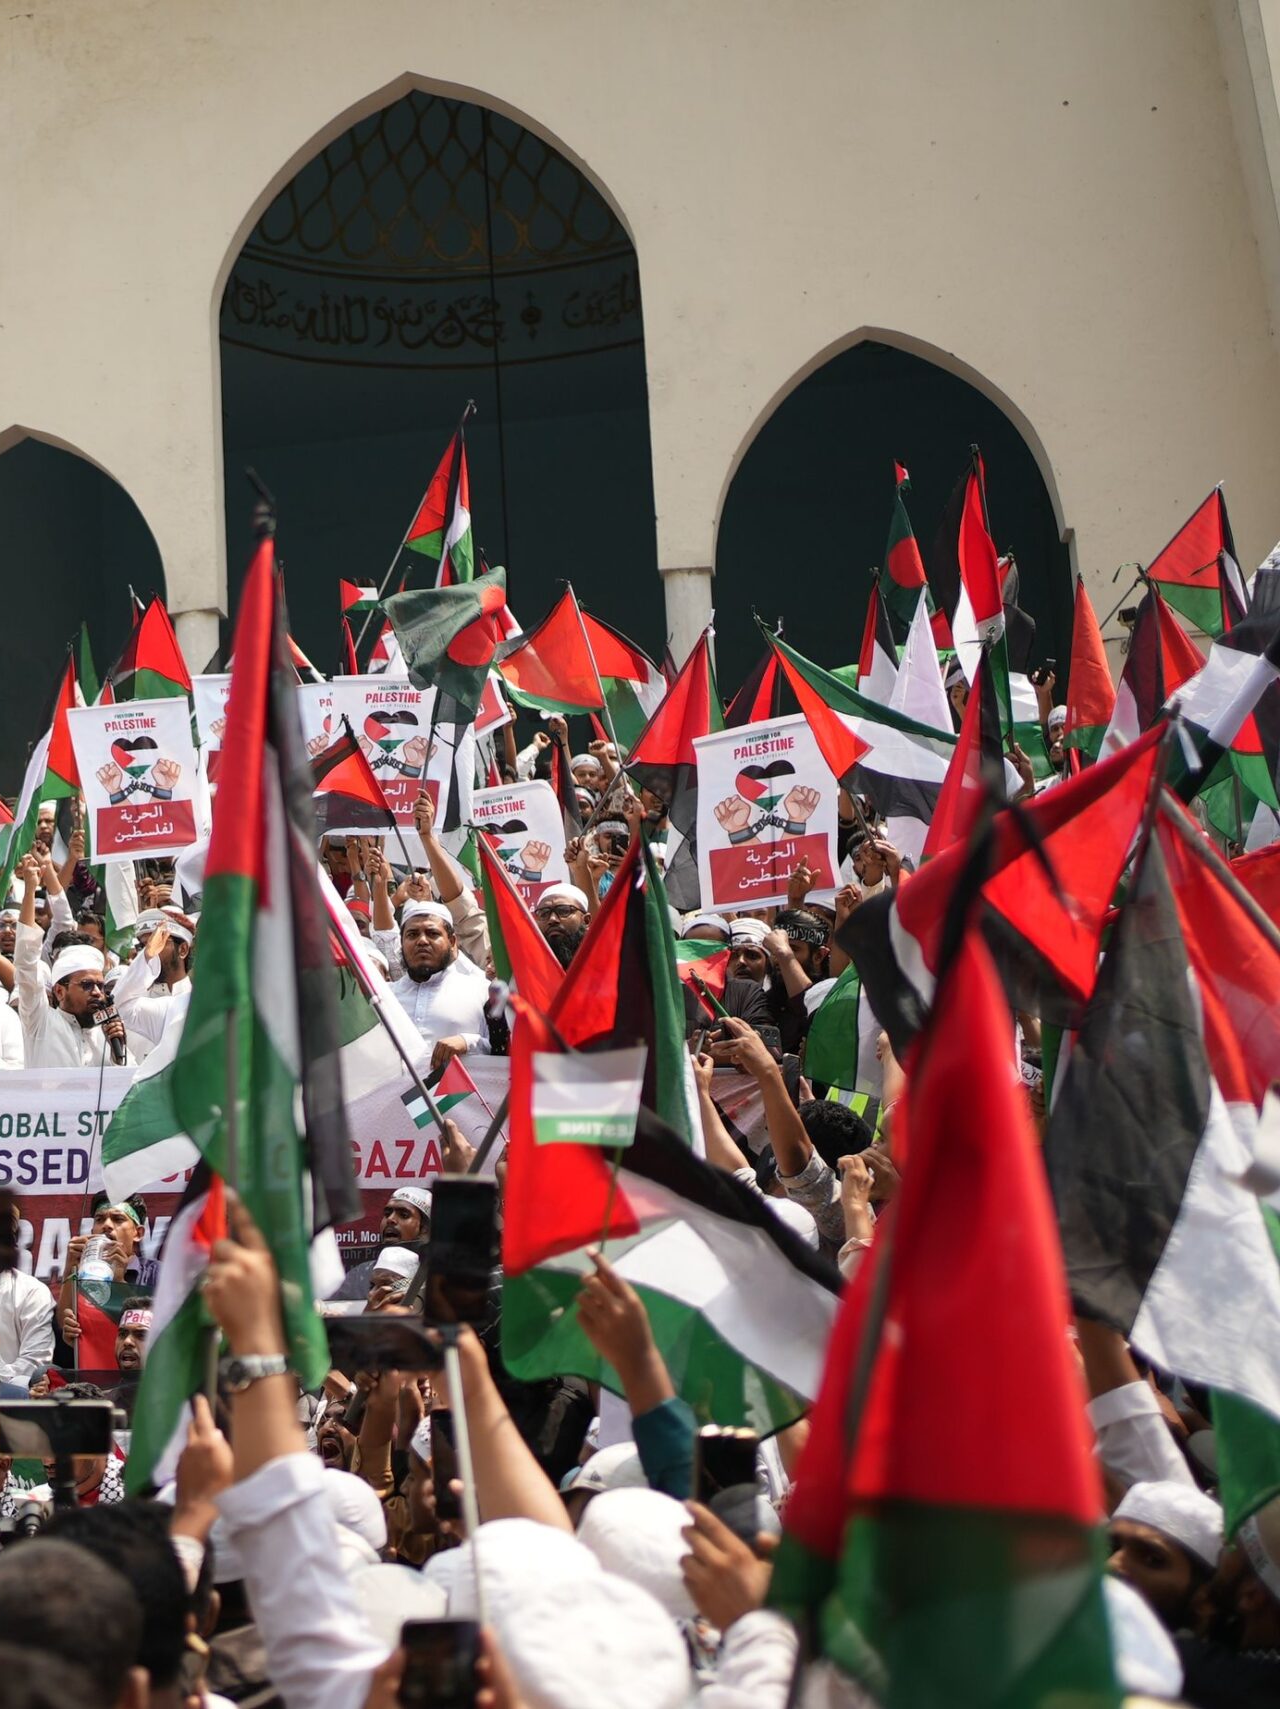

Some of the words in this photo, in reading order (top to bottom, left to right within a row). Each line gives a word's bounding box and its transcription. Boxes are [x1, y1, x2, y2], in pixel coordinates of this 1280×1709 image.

[365, 692, 422, 704] PALESTINE
[104, 718, 157, 732] PALESTINE
[734, 737, 794, 760] PALESTINE
[120, 805, 163, 823] الحرية
[473, 800, 526, 818] PALESTINE
[115, 822, 174, 843] لفلسطين
[746, 842, 796, 865] الحرية
[347, 1139, 444, 1179] GAZA
[335, 1230, 358, 1244] pril,
